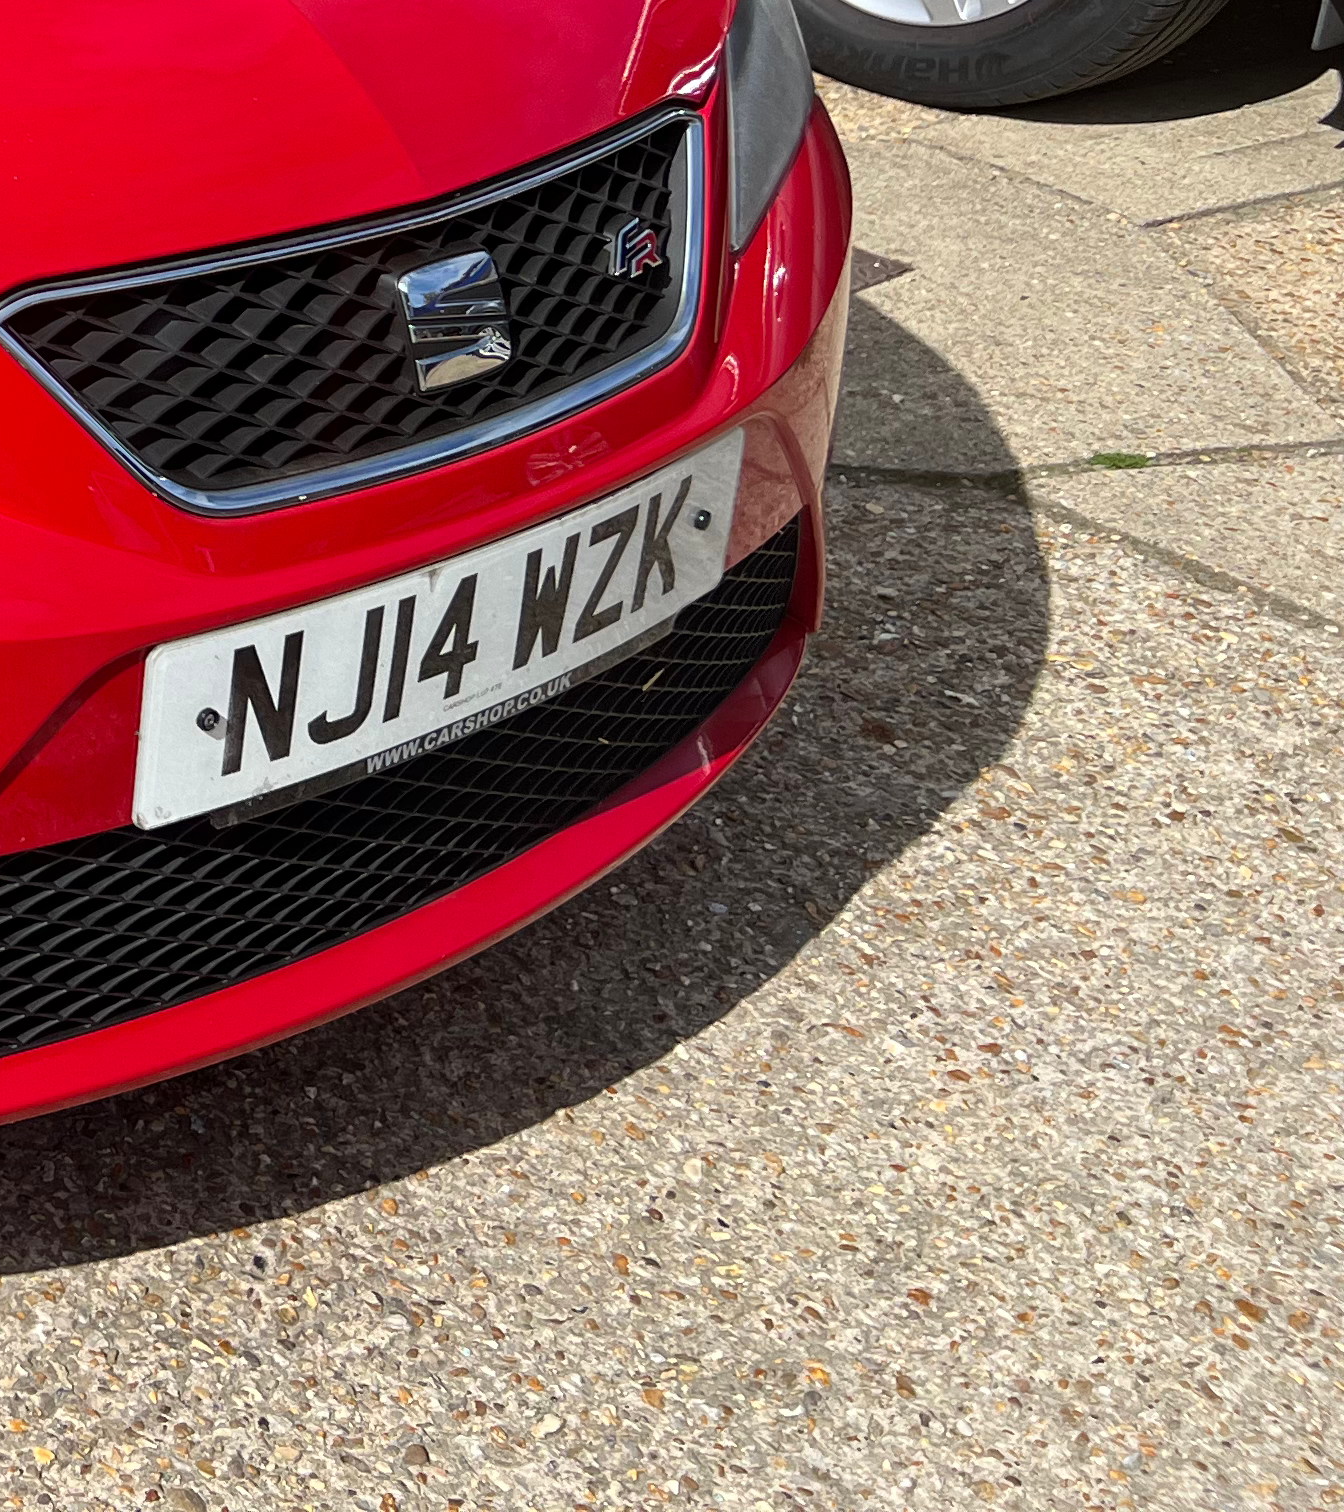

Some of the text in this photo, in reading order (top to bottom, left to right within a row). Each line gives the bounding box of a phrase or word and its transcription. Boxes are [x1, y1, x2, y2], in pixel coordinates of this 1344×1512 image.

[615, 217, 663, 278] FR
[221, 474, 693, 775] NJ14 WZK
[365, 671, 574, 774] WWW.CARSHOP.CO.UK
